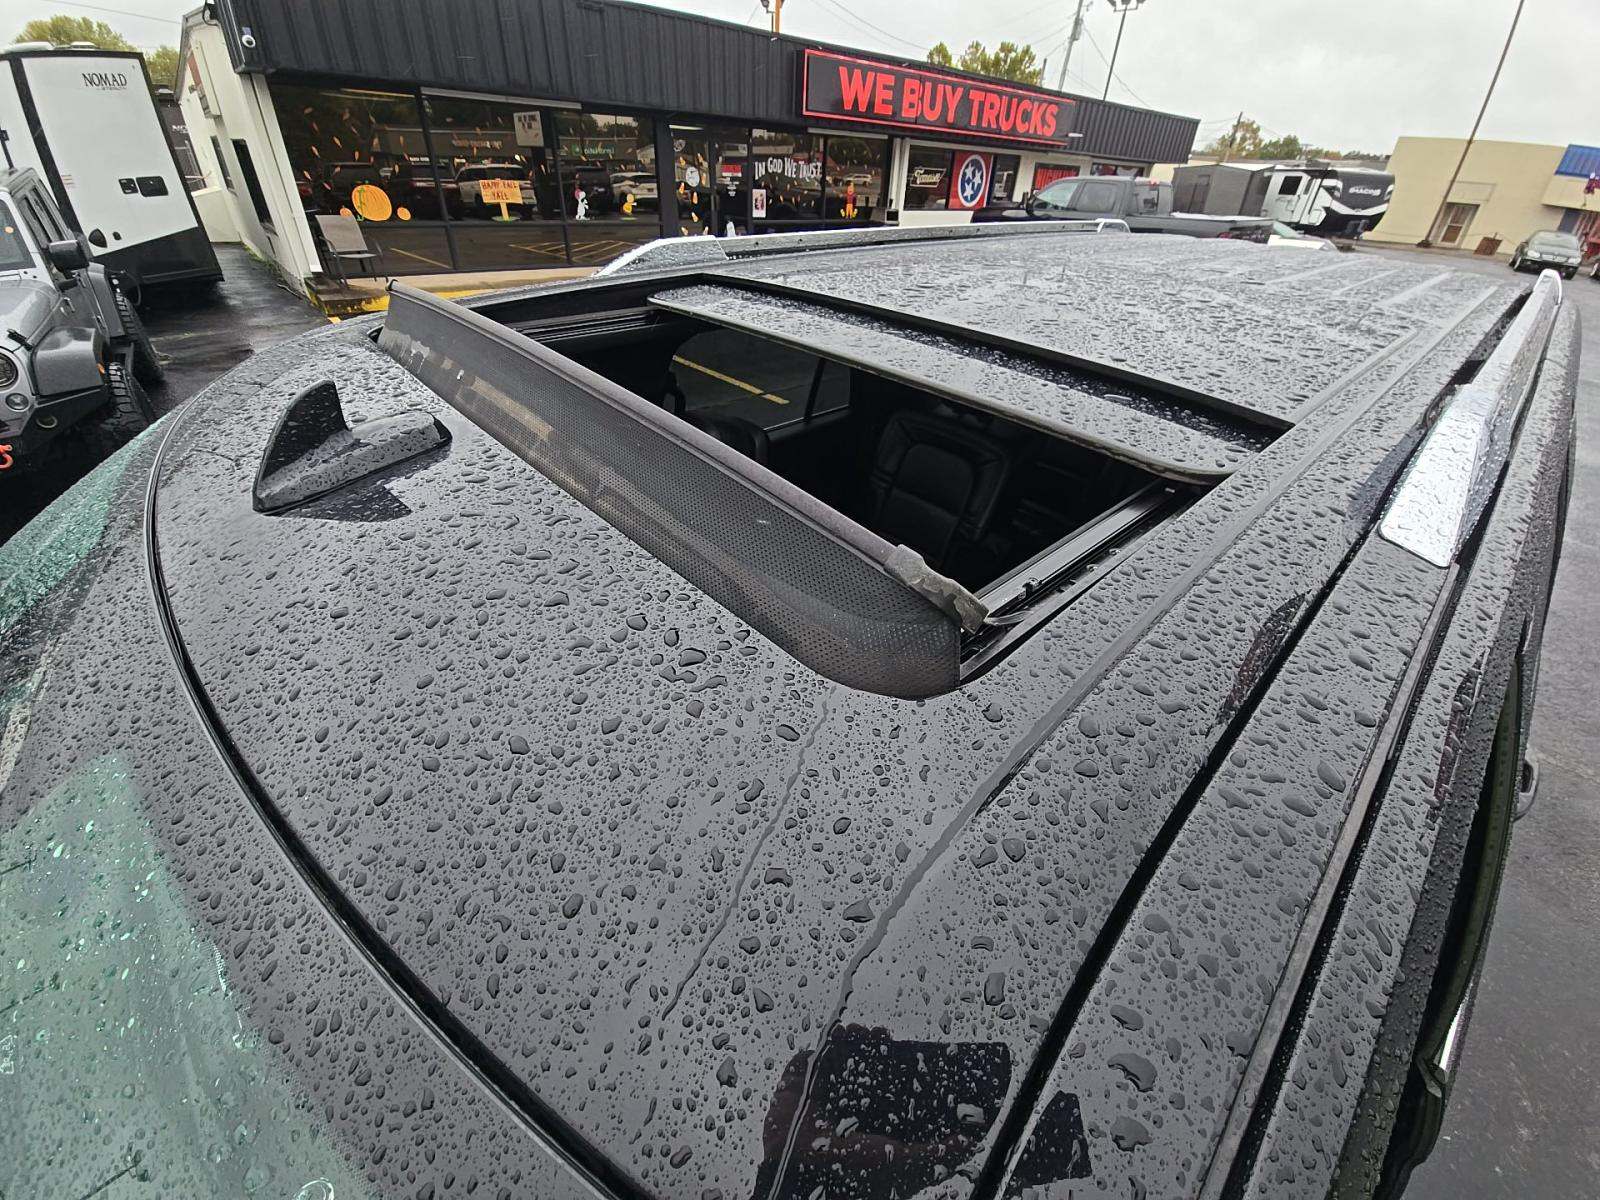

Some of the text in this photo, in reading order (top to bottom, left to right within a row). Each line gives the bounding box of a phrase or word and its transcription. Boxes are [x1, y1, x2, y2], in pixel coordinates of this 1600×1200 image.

[81, 72, 127, 87] NOMAD
[839, 66, 1059, 137] WE BUY TRUCKS
[754, 161, 766, 181] IN
[767, 157, 783, 174] GOD
[784, 156, 798, 178] WE
[798, 160, 823, 179] TRUST
